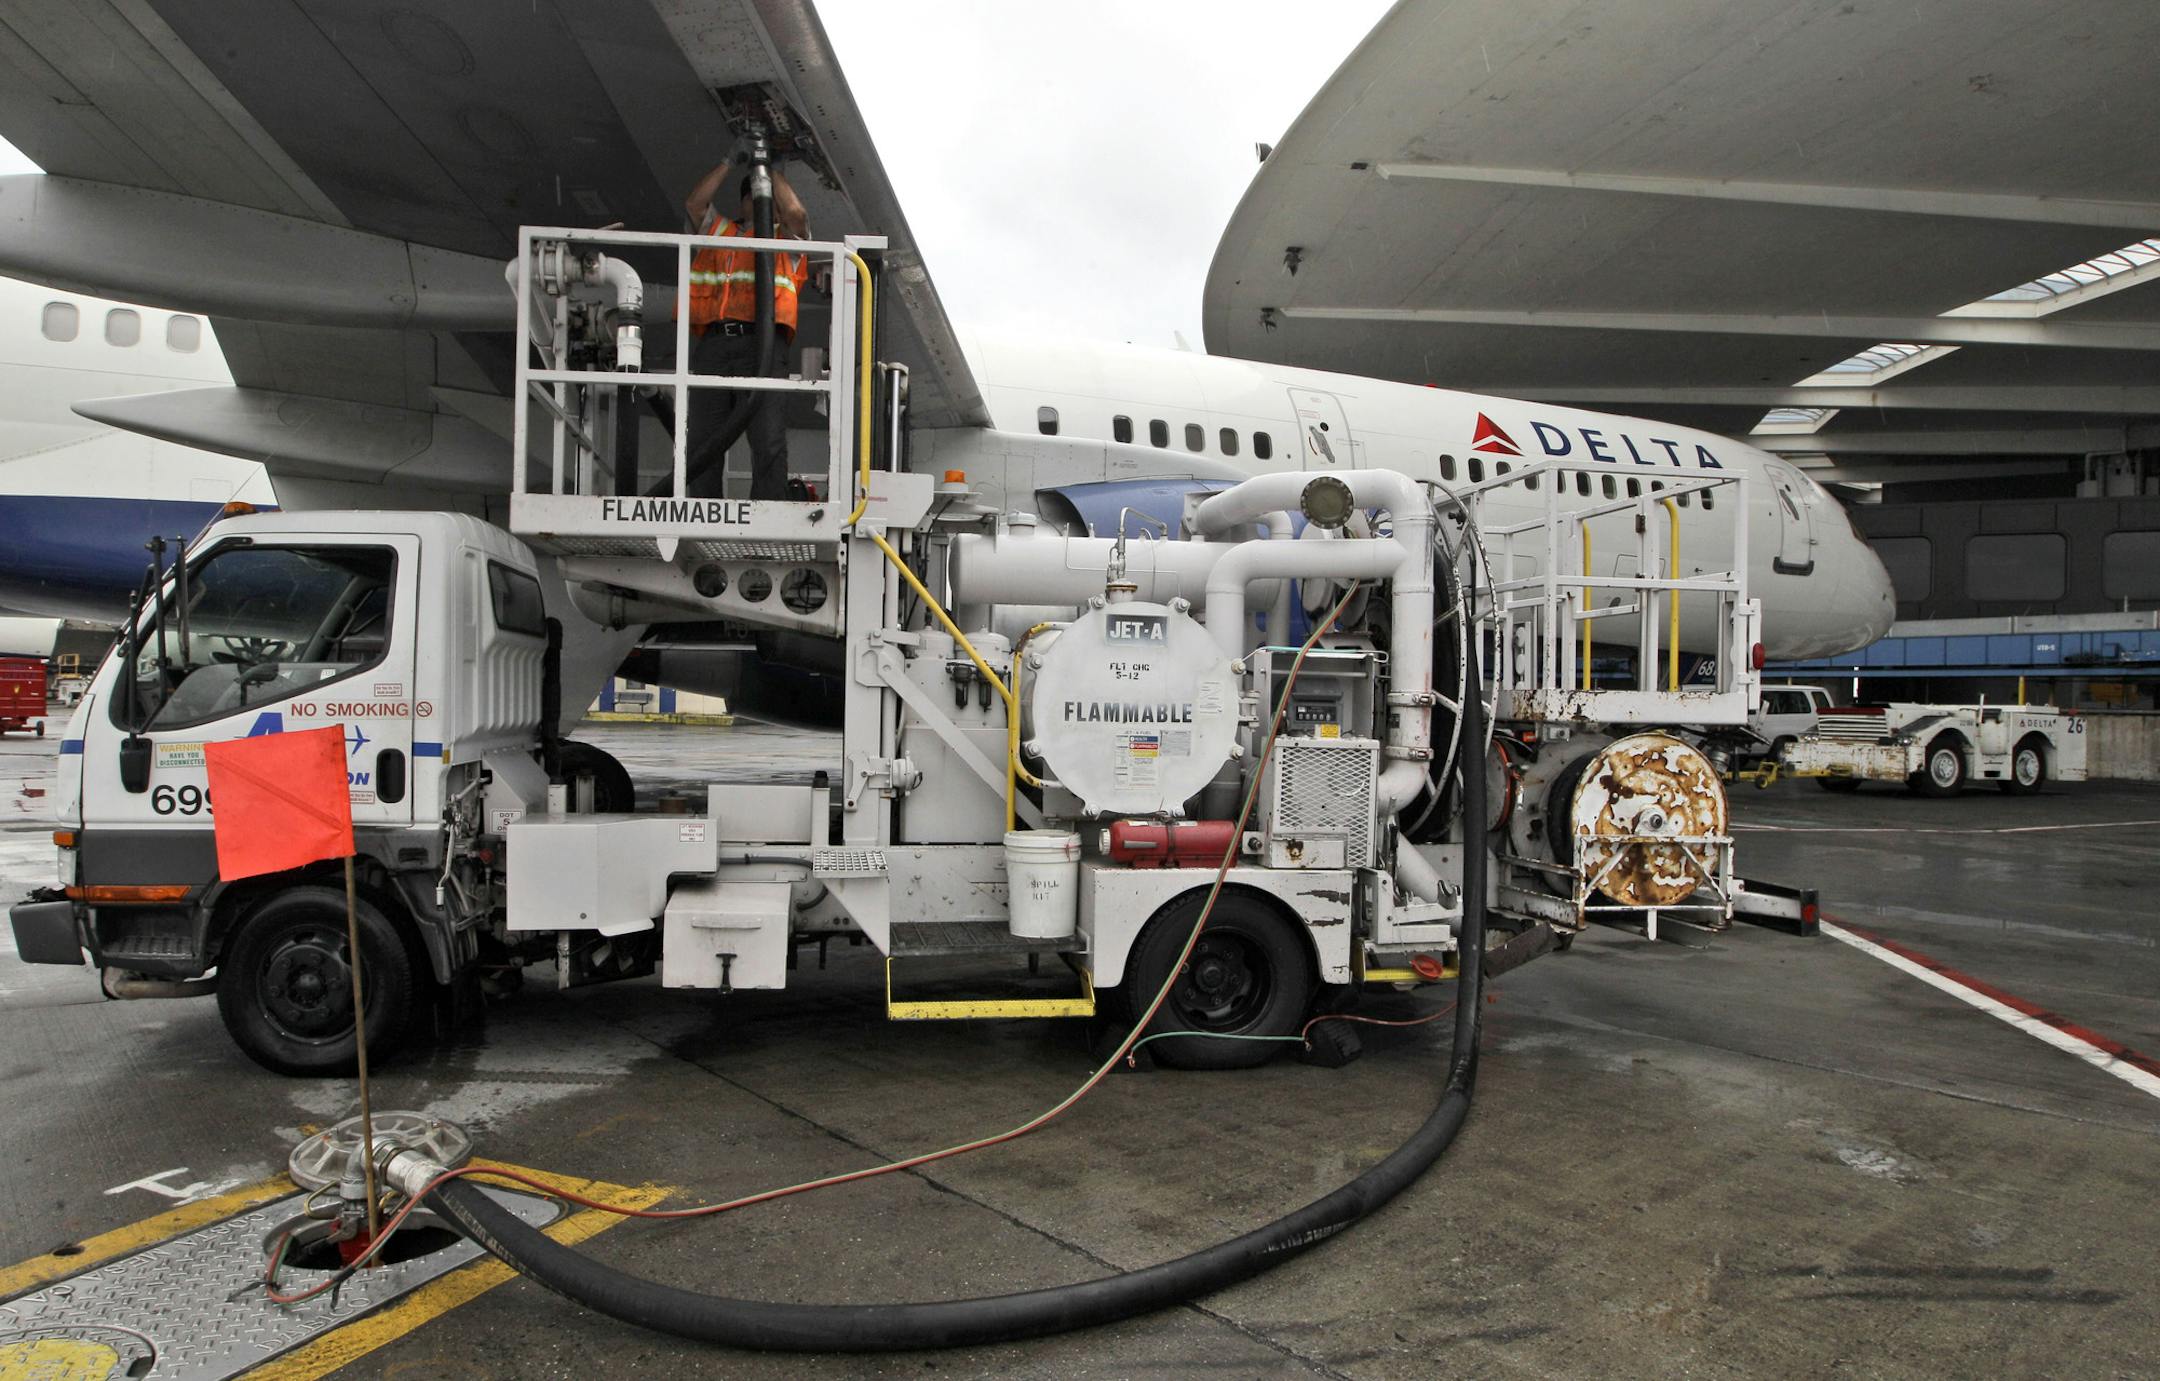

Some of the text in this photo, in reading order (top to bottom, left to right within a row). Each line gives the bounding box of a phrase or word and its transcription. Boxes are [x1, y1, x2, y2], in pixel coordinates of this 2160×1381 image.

[1530, 420, 1724, 469] DELTA
[603, 499, 751, 525] FLAMMABLE
[1698, 660, 1717, 676] 68
[291, 702, 409, 718] NO SMOKING
[1064, 701, 1193, 724] FLAMMABLE
[2027, 719, 2053, 728] DELTA
[2067, 718, 2083, 733] 26
[1031, 879, 1060, 888] SPILL
[175, 1212, 266, 1247] COSTA
[78, 1247, 171, 1282] MESA
